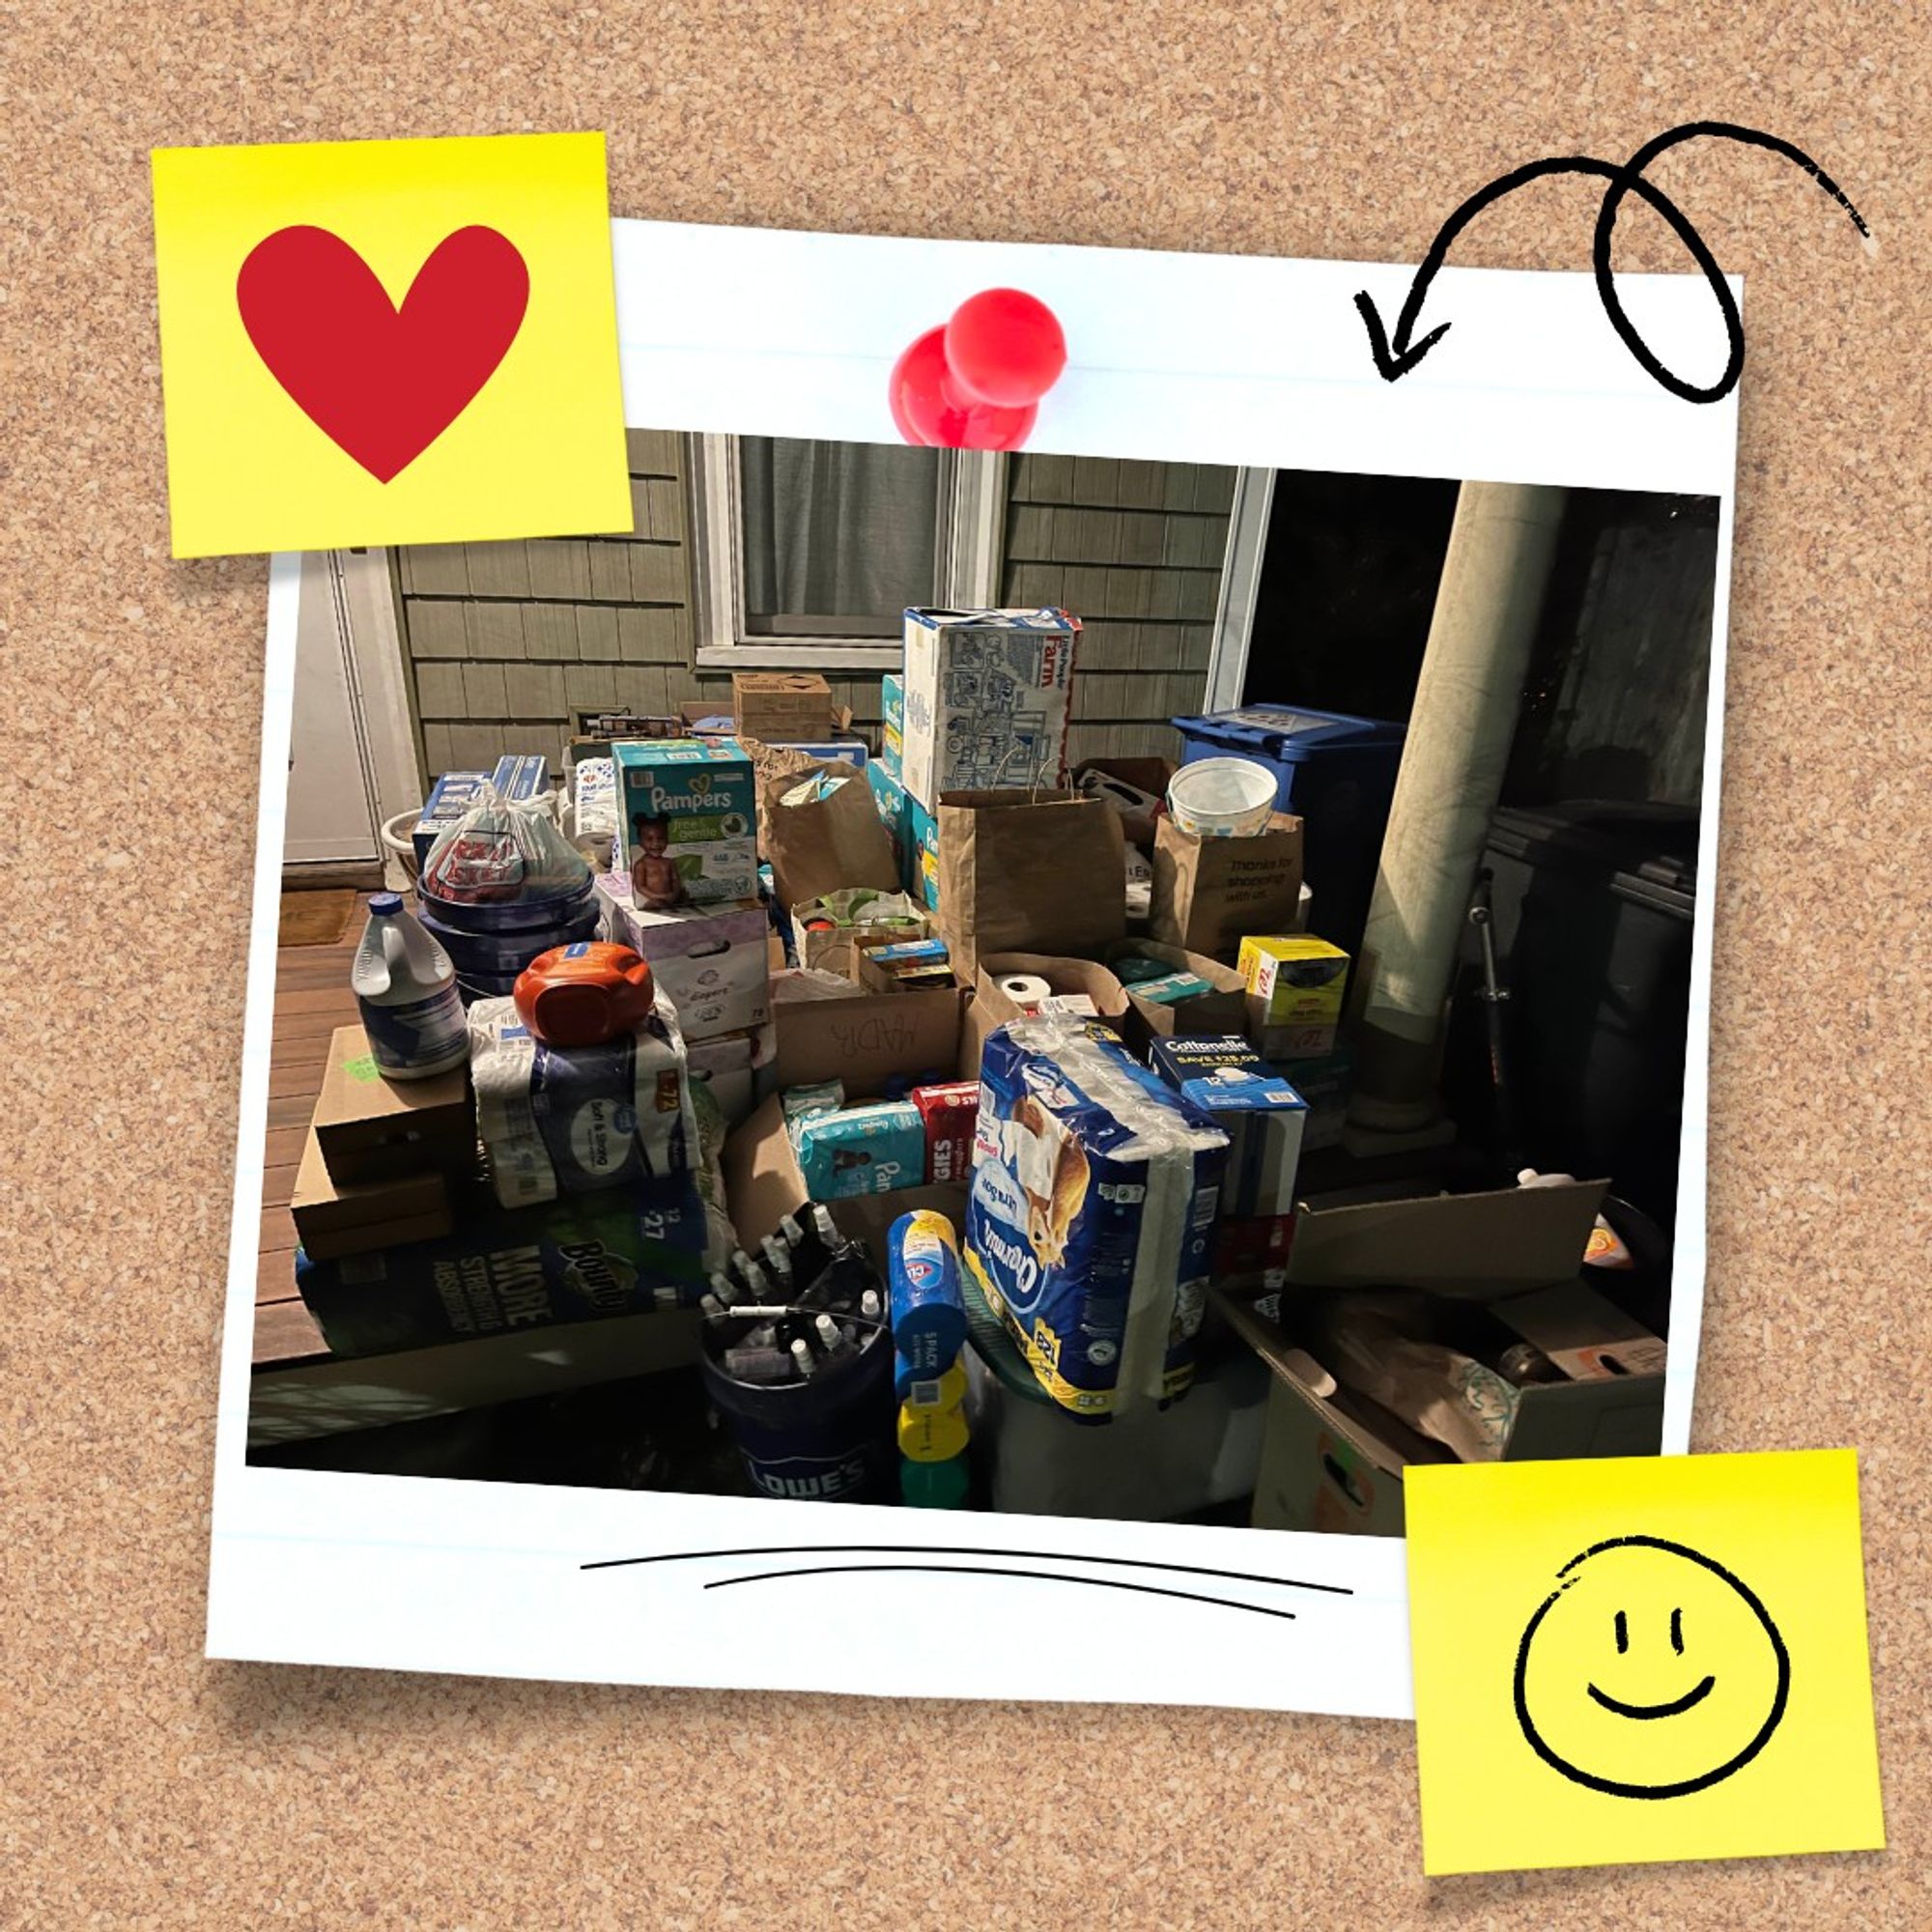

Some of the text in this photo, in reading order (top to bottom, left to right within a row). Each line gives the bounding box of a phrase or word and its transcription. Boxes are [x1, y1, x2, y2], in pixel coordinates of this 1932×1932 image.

[1040, 634, 1063, 689] Farm
[650, 786, 732, 813] Pampers
[1165, 1040, 1252, 1053] Cottonelle
[590, 1101, 604, 1122] Soft
[593, 1133, 609, 1166] Strong
[935, 1139, 952, 1185] GIES
[558, 1238, 630, 1312] Bounty
[983, 1218, 1038, 1294] Charmin
[490, 1244, 554, 1327] MORE
[748, 1457, 867, 1499] LOWE'S
